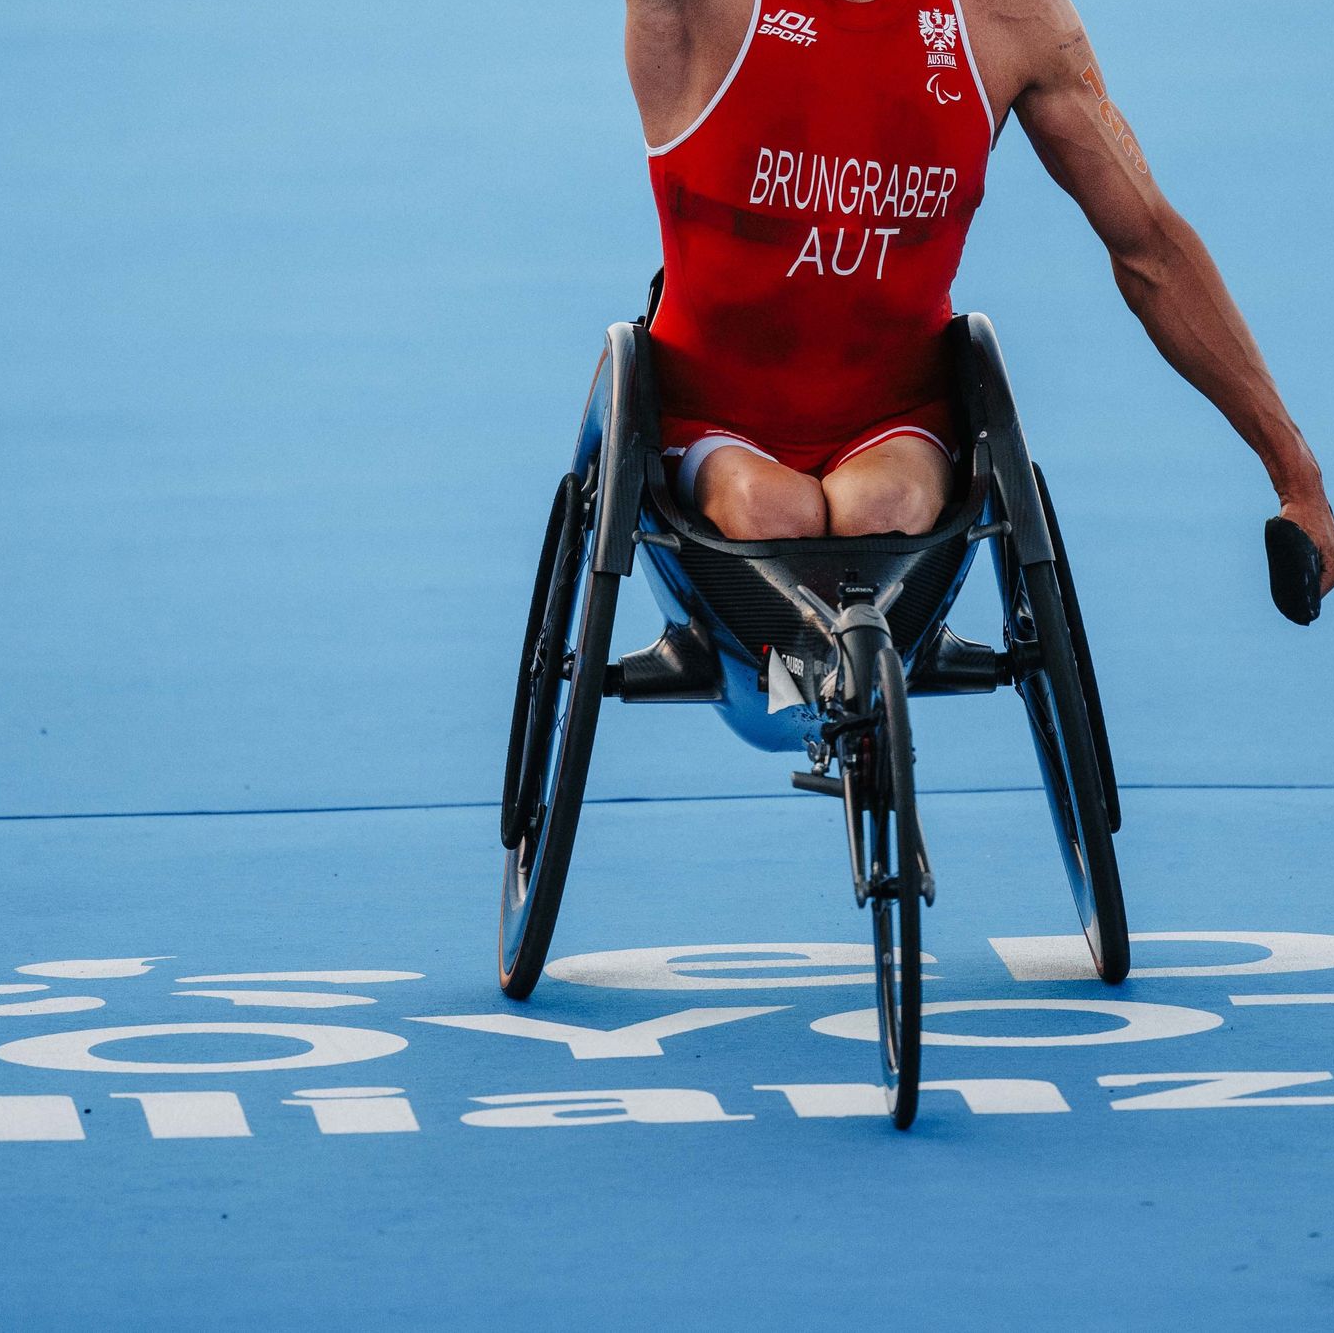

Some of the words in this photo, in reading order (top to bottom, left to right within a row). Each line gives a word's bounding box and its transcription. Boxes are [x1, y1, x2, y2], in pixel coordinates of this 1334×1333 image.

[757, 23, 817, 47] SPORT
[762, 9, 818, 36] JOL
[927, 54, 957, 67] AUSTRIA
[749, 147, 956, 218] BRUNGRABER
[786, 227, 900, 280] AUT
